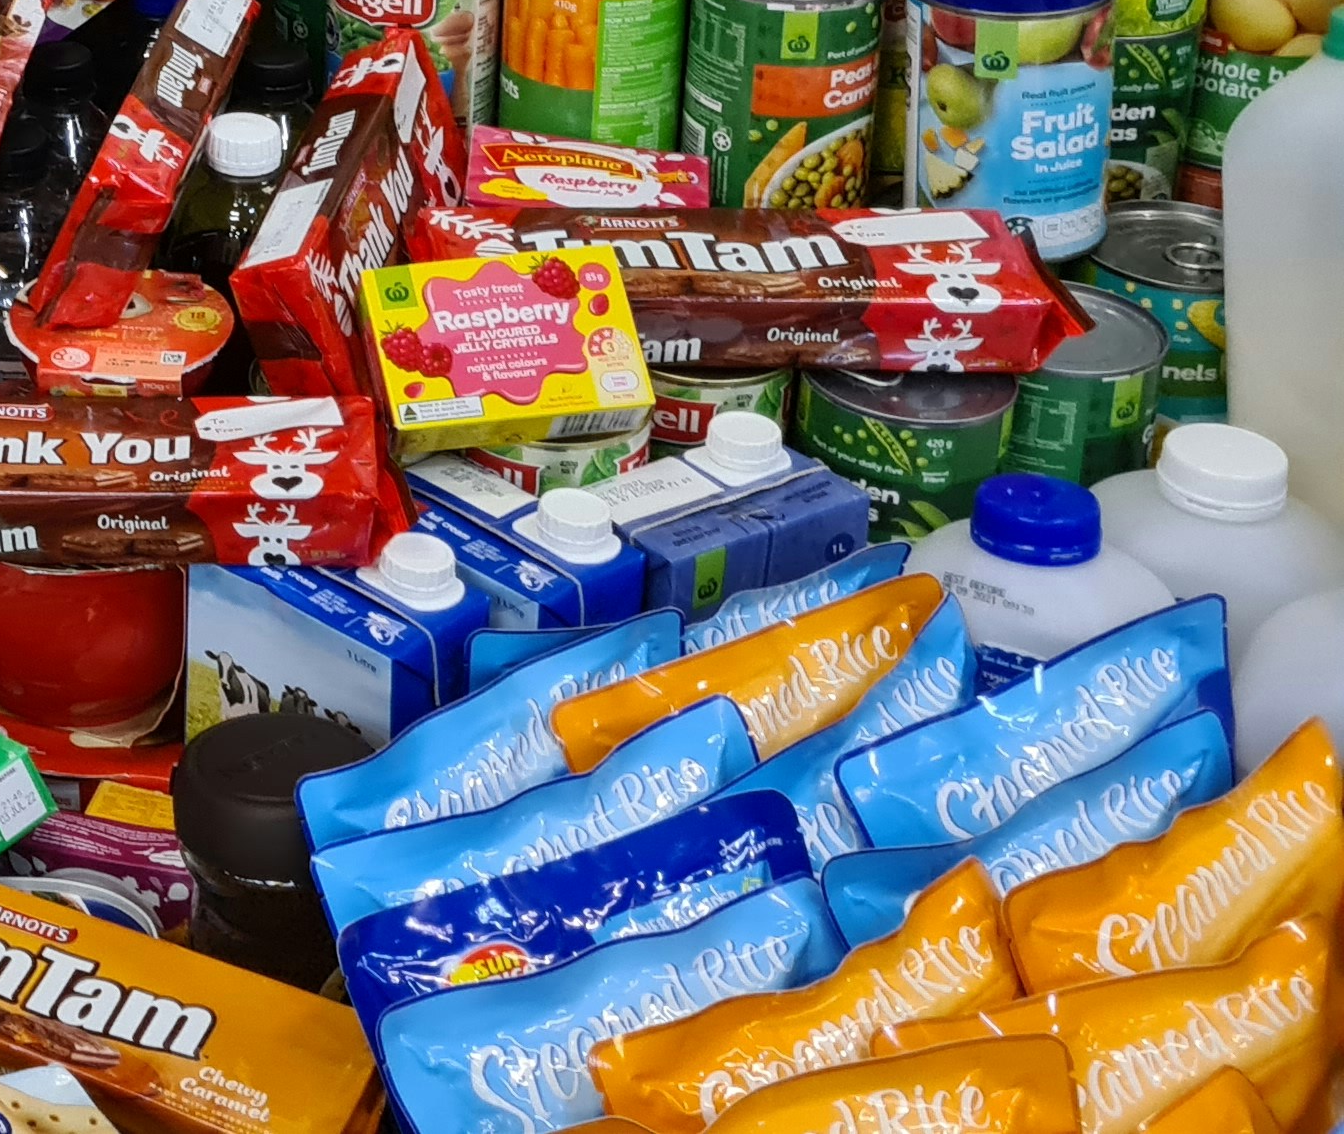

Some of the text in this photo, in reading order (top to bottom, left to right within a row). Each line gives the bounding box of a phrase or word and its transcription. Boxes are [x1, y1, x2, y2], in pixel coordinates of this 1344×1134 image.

[1021, 104, 1094, 134] Fruit
[1010, 126, 1100, 161] Salad
[539, 170, 638, 194] Raspberry
[453, 283, 524, 300] Tasty treat
[817, 274, 902, 291] Original
[432, 302, 570, 333] Raspberry
[454, 333, 558, 354] JELLY CRYSTALS
[465, 325, 541, 342] FLAVOURED
[767, 326, 839, 345] Original
[493, 368, 536, 380] flavours
[81, 432, 191, 465] You
[97, 513, 169, 535] Original
[197, 1065, 268, 1105] Chewy
[179, 1076, 272, 1123] Caramel
